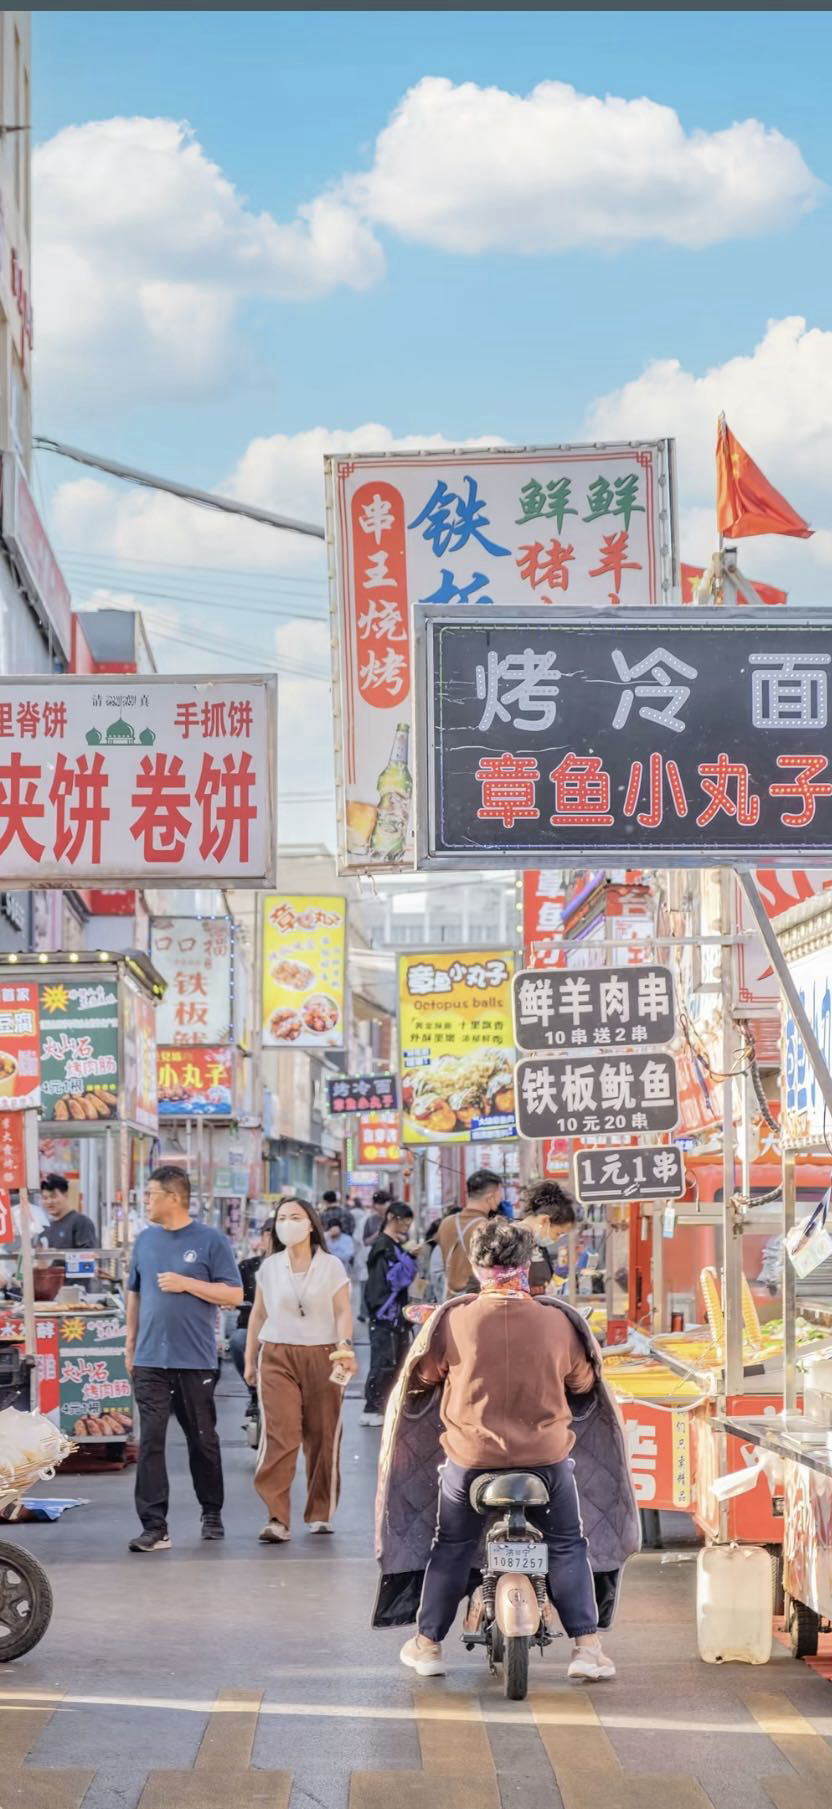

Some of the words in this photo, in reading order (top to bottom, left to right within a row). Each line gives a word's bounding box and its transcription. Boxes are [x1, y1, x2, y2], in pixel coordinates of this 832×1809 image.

[515, 477, 579, 603] 鲜猪
[582, 473, 646, 603] 鲜羊
[357, 494, 408, 697] 串王烧烤
[475, 648, 831, 733] 烤冷面
[174, 700, 253, 739] 手抓饼
[130, 751, 258, 864] 卷饼
[475, 752, 832, 829] 章鱼小丸子
[414, 1000, 468, 1011] Octopus
[473, 997, 504, 1008] balls
[519, 972, 670, 1027] 鲜羊肉串
[545, 1024, 649, 1046] 10串送2串
[522, 1060, 674, 1115] 铁板鱿鱼
[557, 1112, 649, 1133] 10元20串
[581, 1151, 678, 1184] 1元1串
[494, 1557, 543, 1569] 1087257
